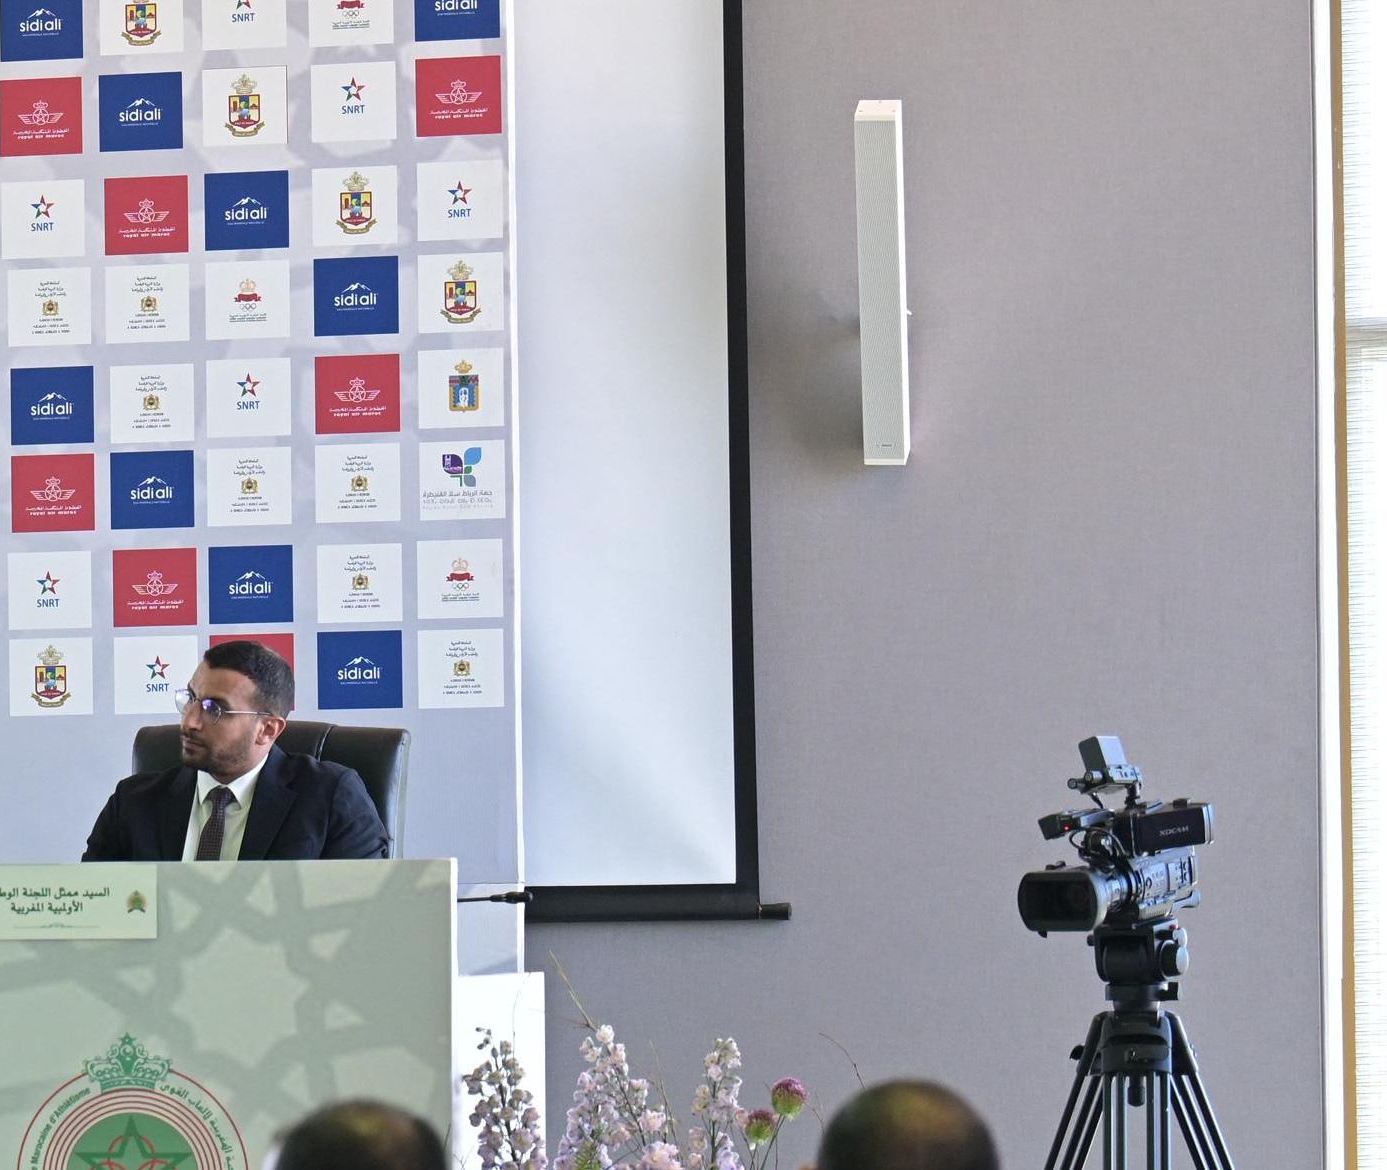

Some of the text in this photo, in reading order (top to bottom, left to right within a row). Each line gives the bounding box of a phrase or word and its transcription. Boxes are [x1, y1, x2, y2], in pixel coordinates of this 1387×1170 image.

[231, 12, 255, 23] SNRT
[19, 18, 61, 33] sidi ali
[119, 107, 161, 122] sidi ali
[341, 104, 365, 115] SNRT
[225, 206, 267, 221] sidi ali
[447, 208, 472, 219] SNRT
[31, 222, 54, 232] SNRT
[334, 292, 377, 307] sidi ali
[30, 401, 73, 416] sidi ali
[236, 400, 260, 411] SNRT
[130, 486, 173, 500] sidi ali
[229, 581, 271, 595] sidi ali
[36, 598, 60, 608] SNRT
[337, 666, 380, 680] sidi ali
[146, 683, 170, 693] SNRT
[22, 887, 51, 900] اللجنة
[54, 887, 78, 899] ممثل
[83, 887, 110, 899] السيد
[11, 902, 44, 915] المغربية
